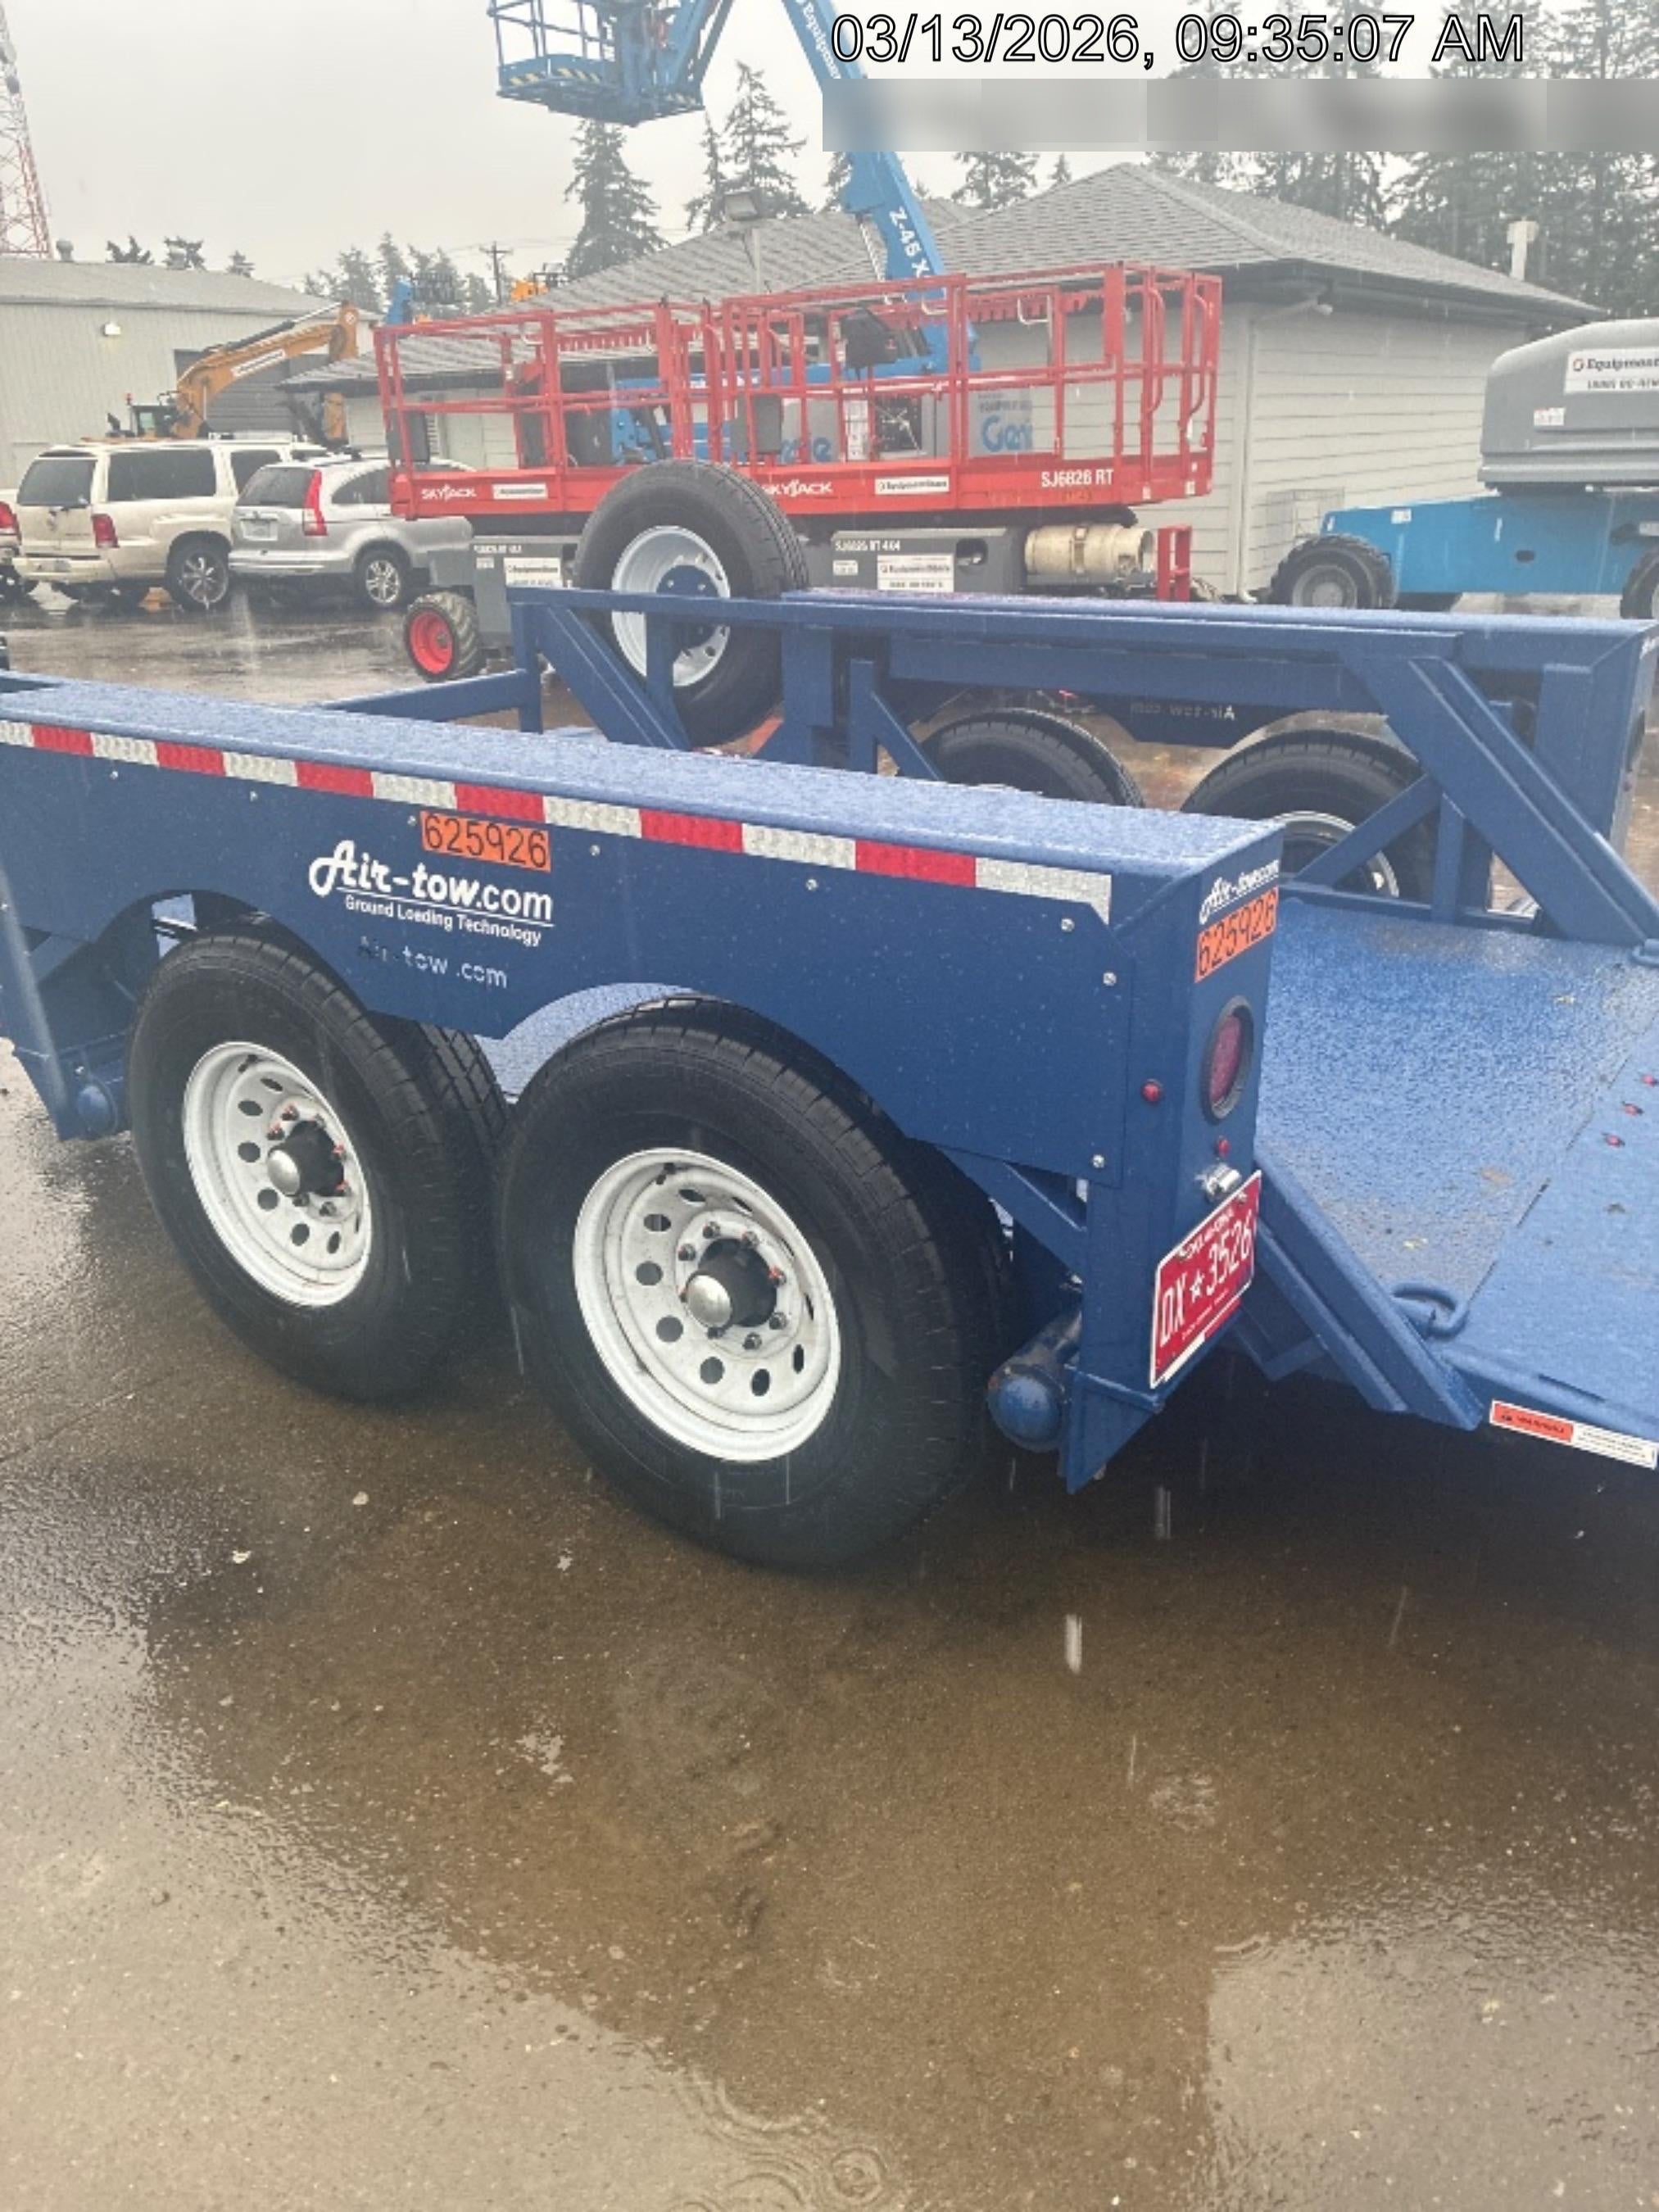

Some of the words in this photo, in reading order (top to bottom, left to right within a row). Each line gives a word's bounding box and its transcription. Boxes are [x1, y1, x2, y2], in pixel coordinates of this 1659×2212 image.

[1095, 469, 1114, 485] RT
[424, 814, 548, 869] 625926
[308, 839, 553, 921] Air-tow.com
[344, 894, 394, 918] Ground
[397, 903, 454, 932] Loading
[456, 913, 542, 947] Technology
[1198, 889, 1278, 977] 625926
[1159, 1271, 1189, 1349] DX
[1205, 1208, 1253, 1298] 3526
